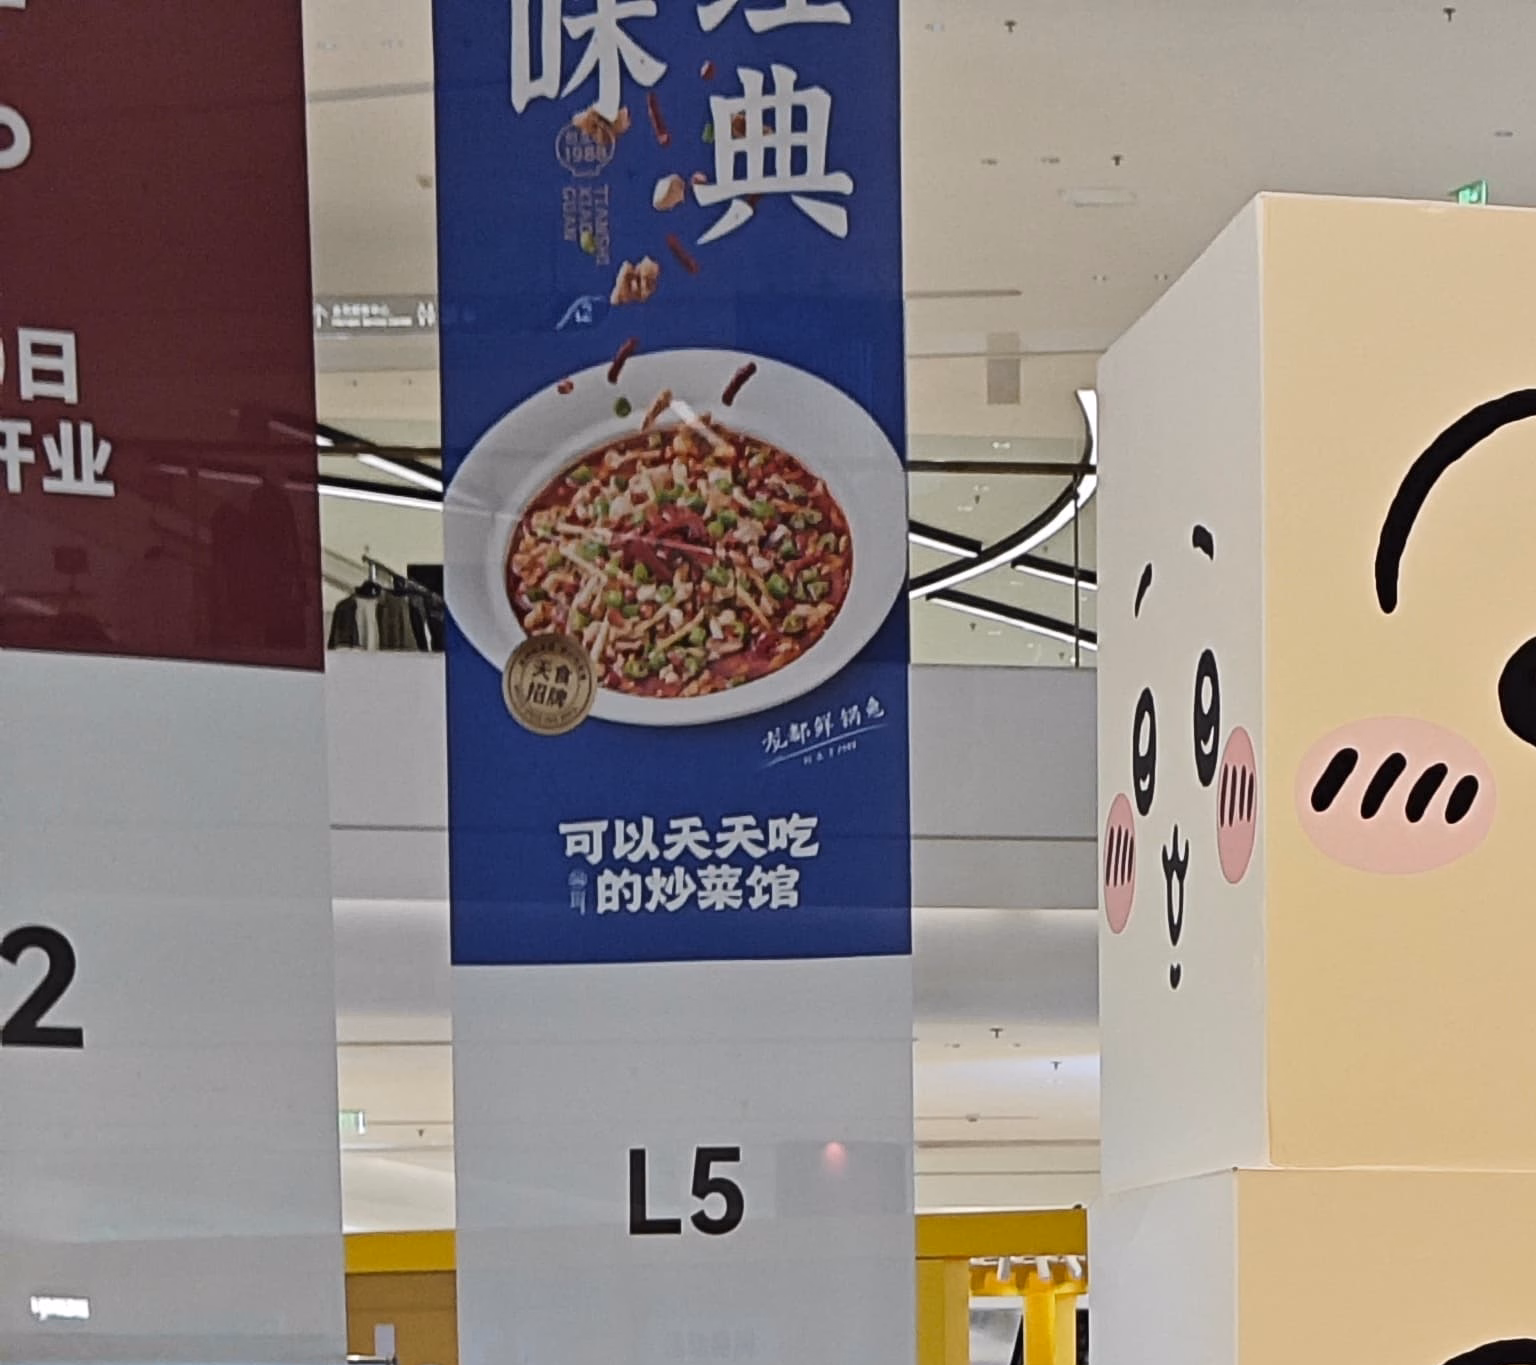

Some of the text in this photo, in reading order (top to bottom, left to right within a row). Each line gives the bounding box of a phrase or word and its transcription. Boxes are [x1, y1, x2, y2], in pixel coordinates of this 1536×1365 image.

[0, 327, 79, 405] 日
[558, 812, 820, 865] 可以天天吃
[596, 863, 800, 915] 的炒菜馆
[0, 925, 84, 1048] 2
[629, 1146, 745, 1236] L5
